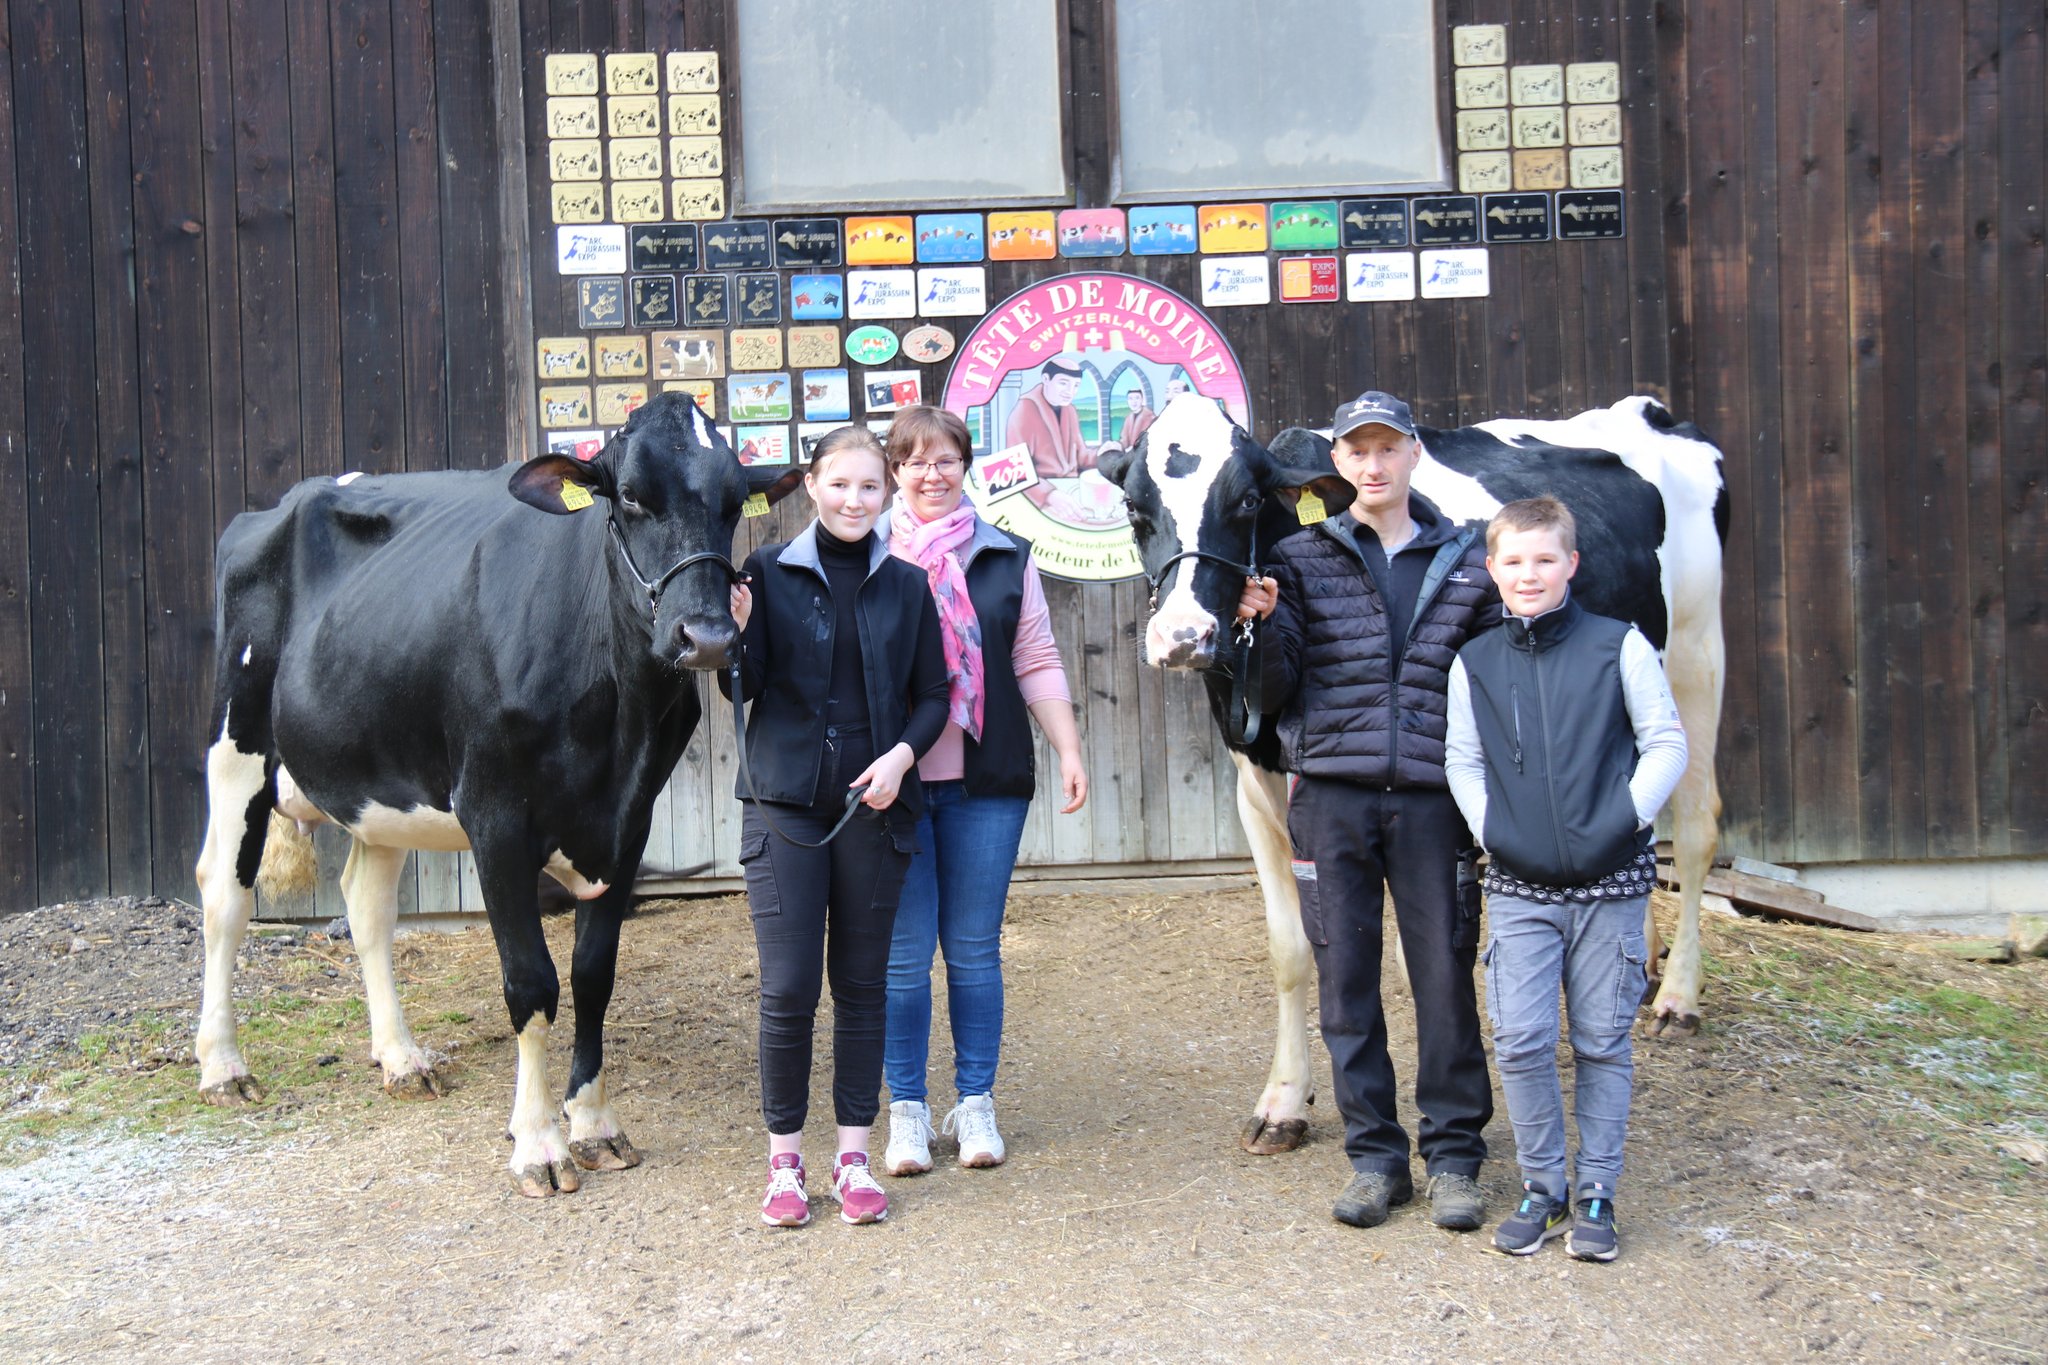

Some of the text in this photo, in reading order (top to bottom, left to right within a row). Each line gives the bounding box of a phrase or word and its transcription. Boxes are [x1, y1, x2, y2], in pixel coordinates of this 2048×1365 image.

[589, 237, 602, 245] ARC
[585, 245, 621, 253] JURASSIEN
[578, 252, 597, 260] EXPO
[1311, 262, 1336, 271] EXPO
[1377, 264, 1390, 272] ARC
[1451, 261, 1464, 269] ARC
[1231, 268, 1245, 276] ARC
[1228, 276, 1264, 284] JURASSIEN
[1366, 280, 1384, 288] EXPO
[1440, 277, 1458, 285] EXPO
[878, 282, 892, 290] ARC
[1221, 285, 1239, 293] EXPO
[1311, 284, 1336, 294] 2014
[874, 289, 911, 298] JURASSIEN
[944, 287, 980, 296] JURASSIEN
[867, 298, 886, 306] EXPO
[938, 295, 956, 304] EXPO
[962, 280, 1227, 390] TÊTE DE MOINE
[1029, 313, 1161, 352] SWITZERLAND
[1102, 553, 1123, 568] de
